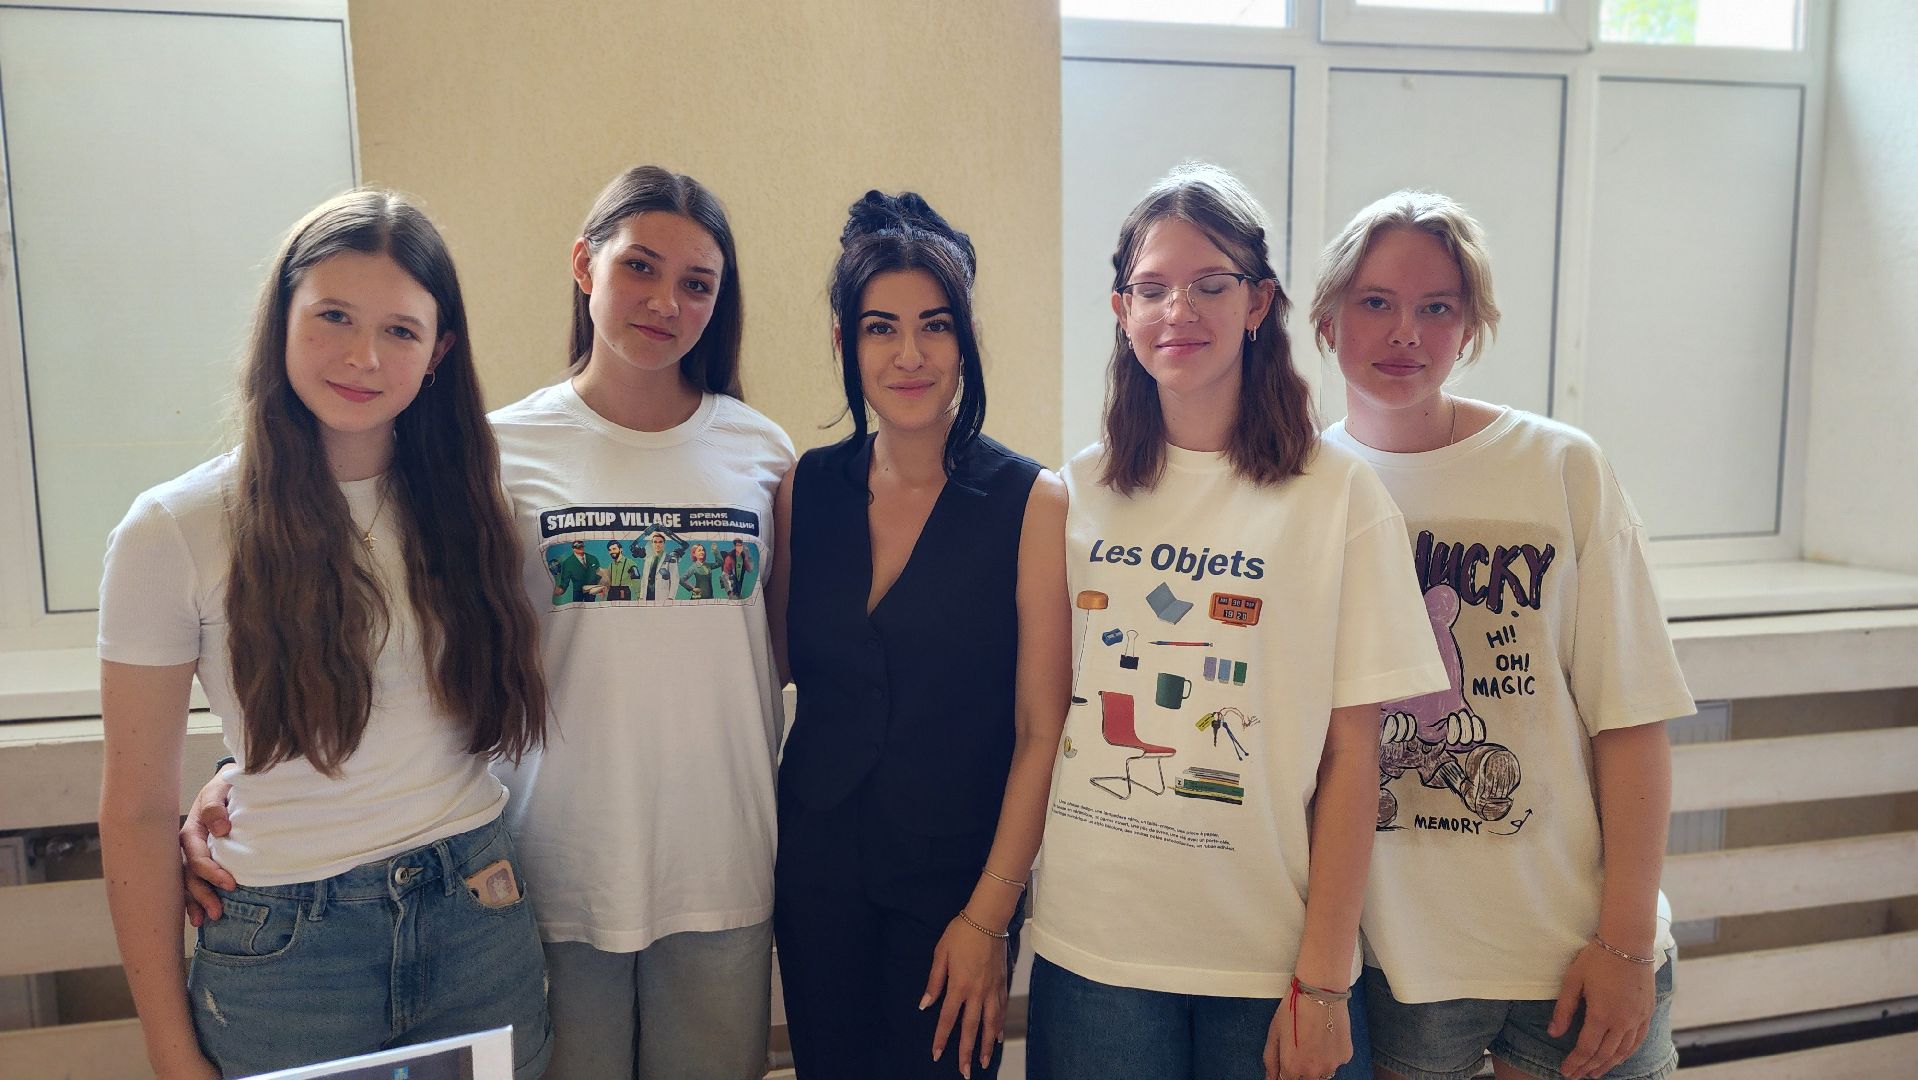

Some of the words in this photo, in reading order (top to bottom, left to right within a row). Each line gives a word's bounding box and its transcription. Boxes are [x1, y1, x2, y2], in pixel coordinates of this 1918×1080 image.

[546, 511, 616, 531] STARTUP
[620, 511, 682, 528] VILLAGE
[689, 519, 755, 530] ИННОВАЦИЙ
[1089, 539, 1143, 566] Les
[1150, 543, 1265, 581] Objets
[1495, 653, 1530, 672] OH!
[1472, 675, 1536, 699] MAGIC
[1414, 813, 1483, 835] MEMORY
